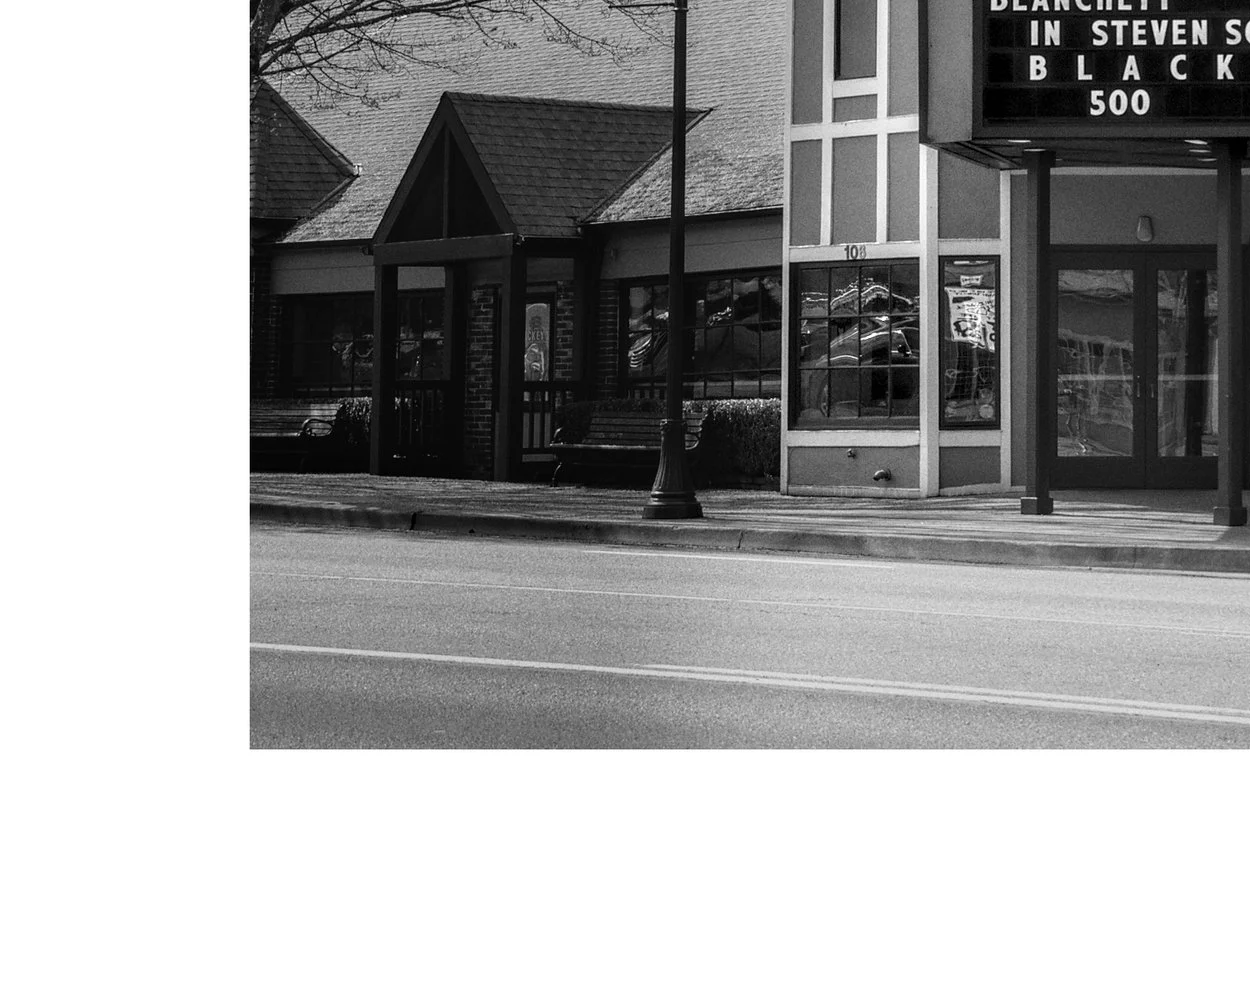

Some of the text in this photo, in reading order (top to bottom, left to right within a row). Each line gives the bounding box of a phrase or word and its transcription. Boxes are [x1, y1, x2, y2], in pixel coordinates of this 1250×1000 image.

[1030, 19, 1061, 46] IN
[1091, 19, 1208, 46] STEVEN
[1089, 88, 1151, 116] 500
